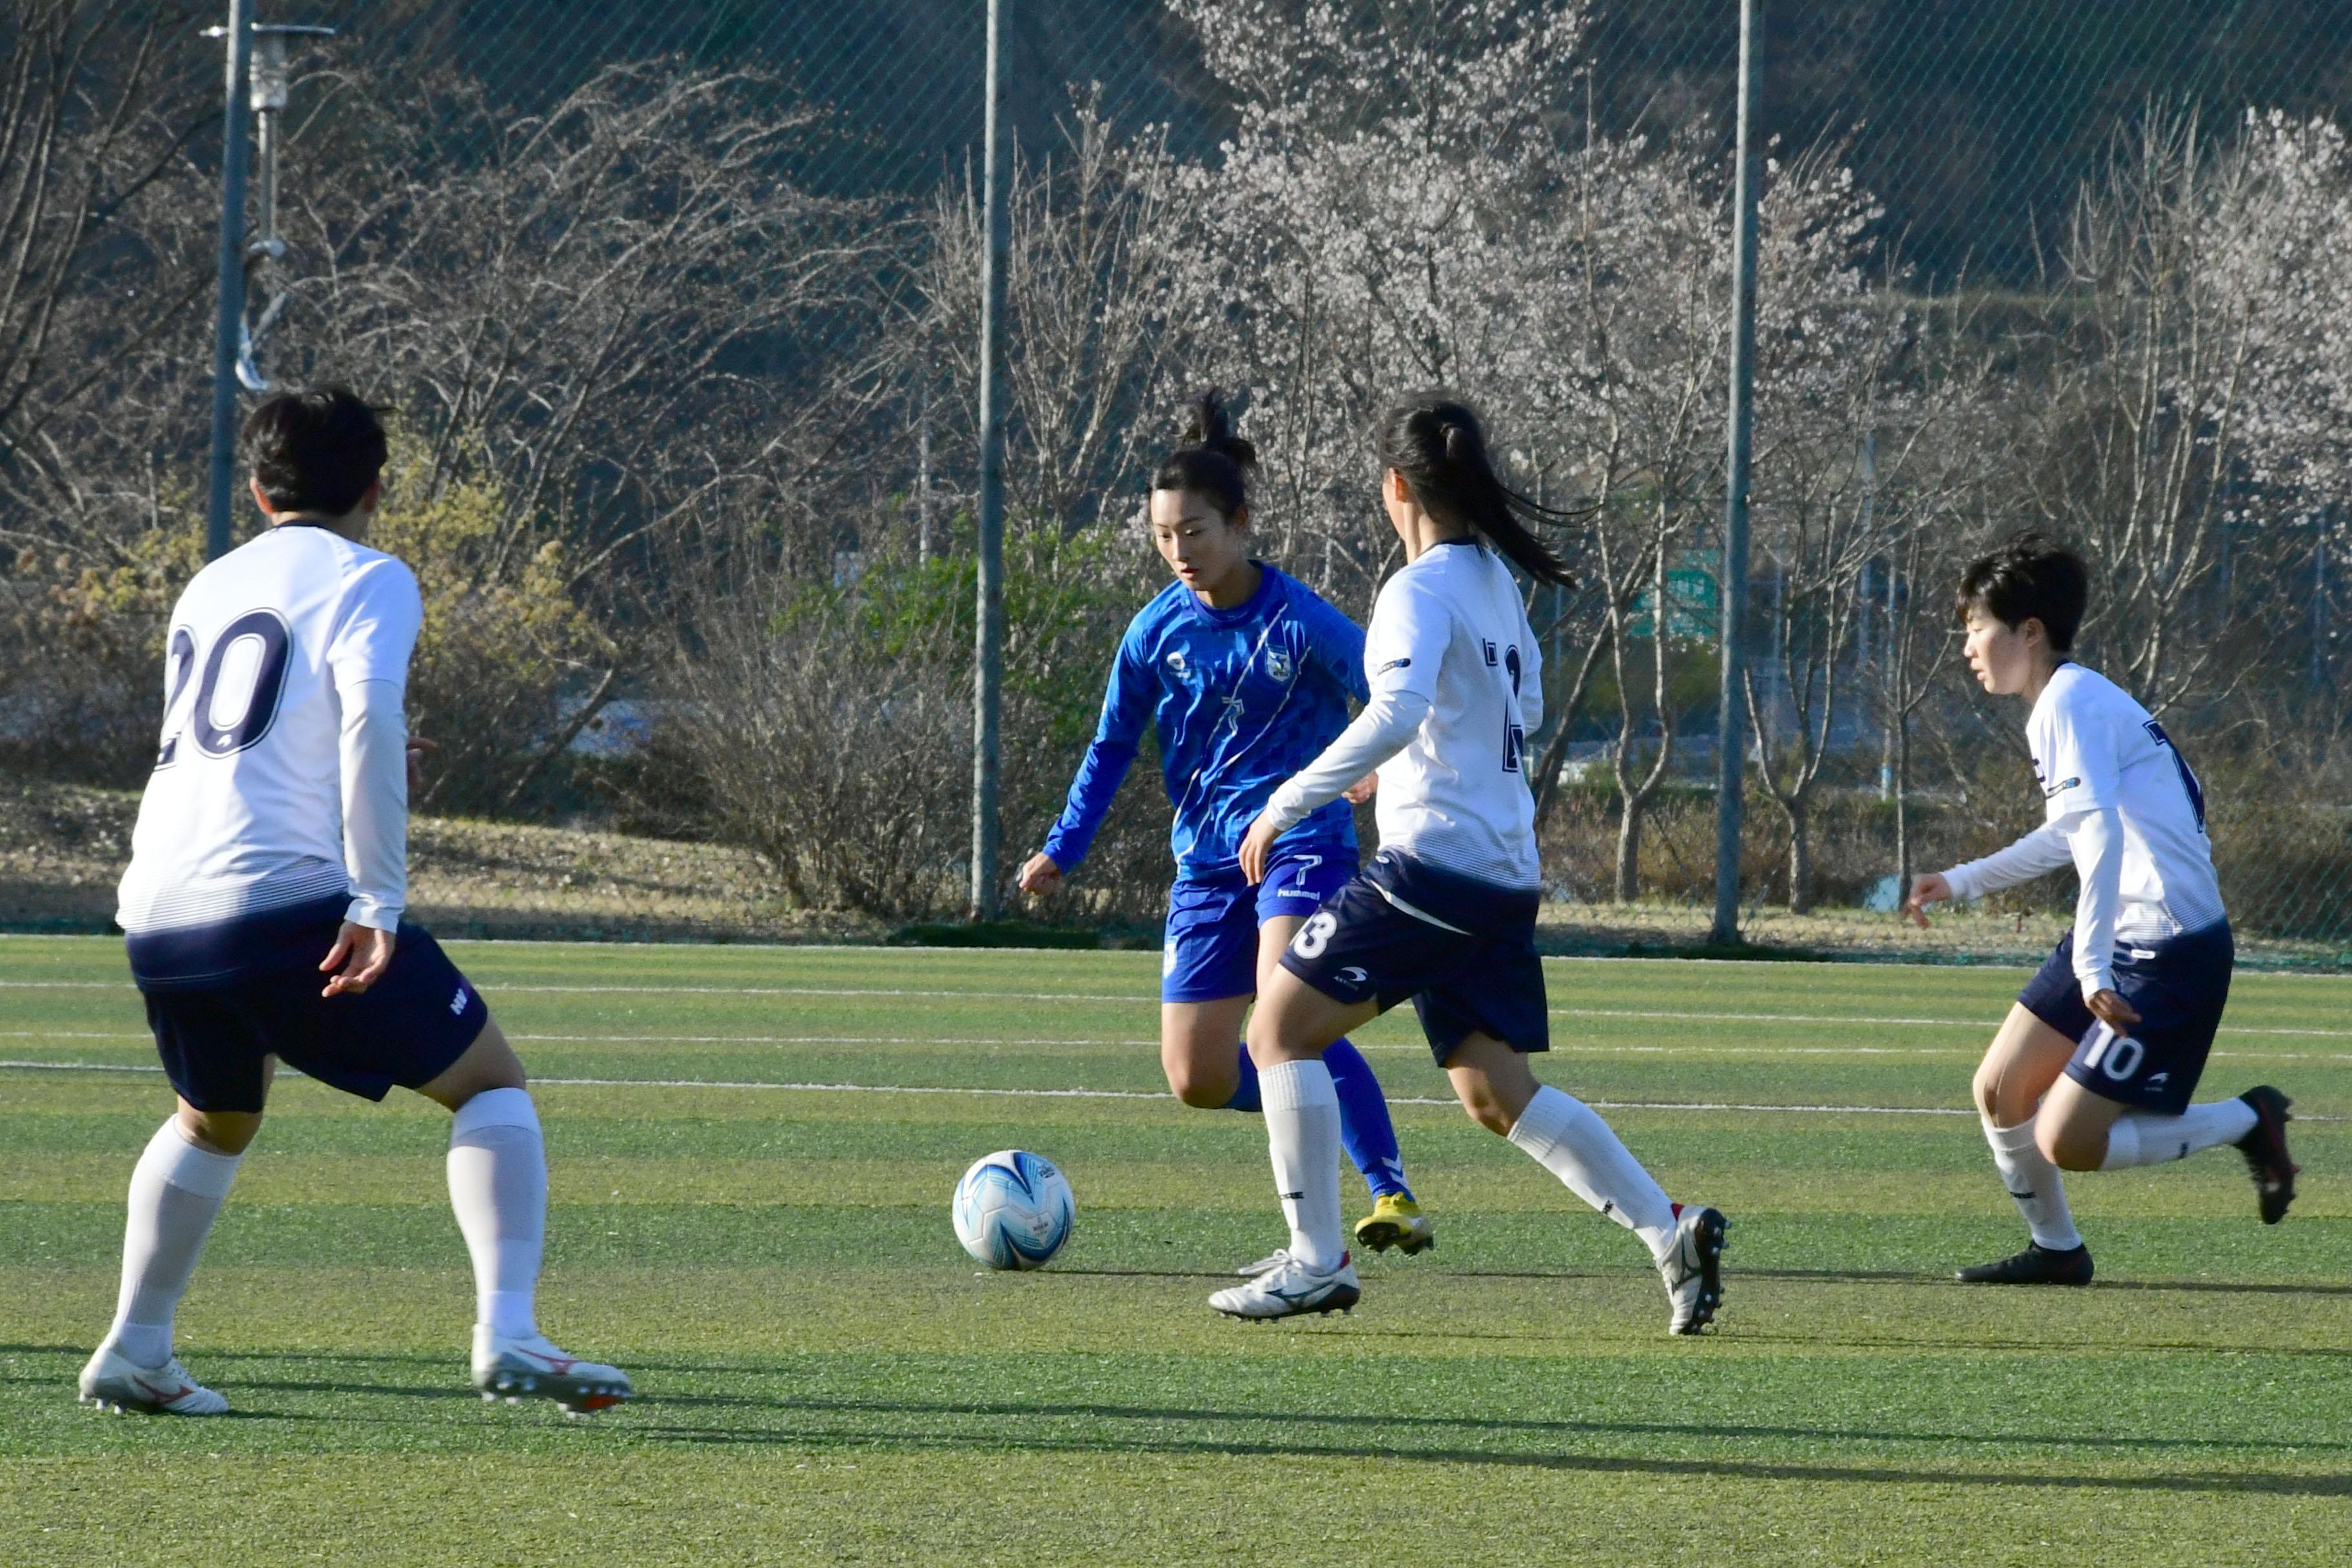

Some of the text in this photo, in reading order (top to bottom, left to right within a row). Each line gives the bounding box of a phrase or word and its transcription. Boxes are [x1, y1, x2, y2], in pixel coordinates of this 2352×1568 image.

[154, 607, 293, 771] 20
[1293, 854, 1323, 886] 7
[1277, 888, 1320, 901] hummel
[2083, 1020, 2144, 1081] 10
